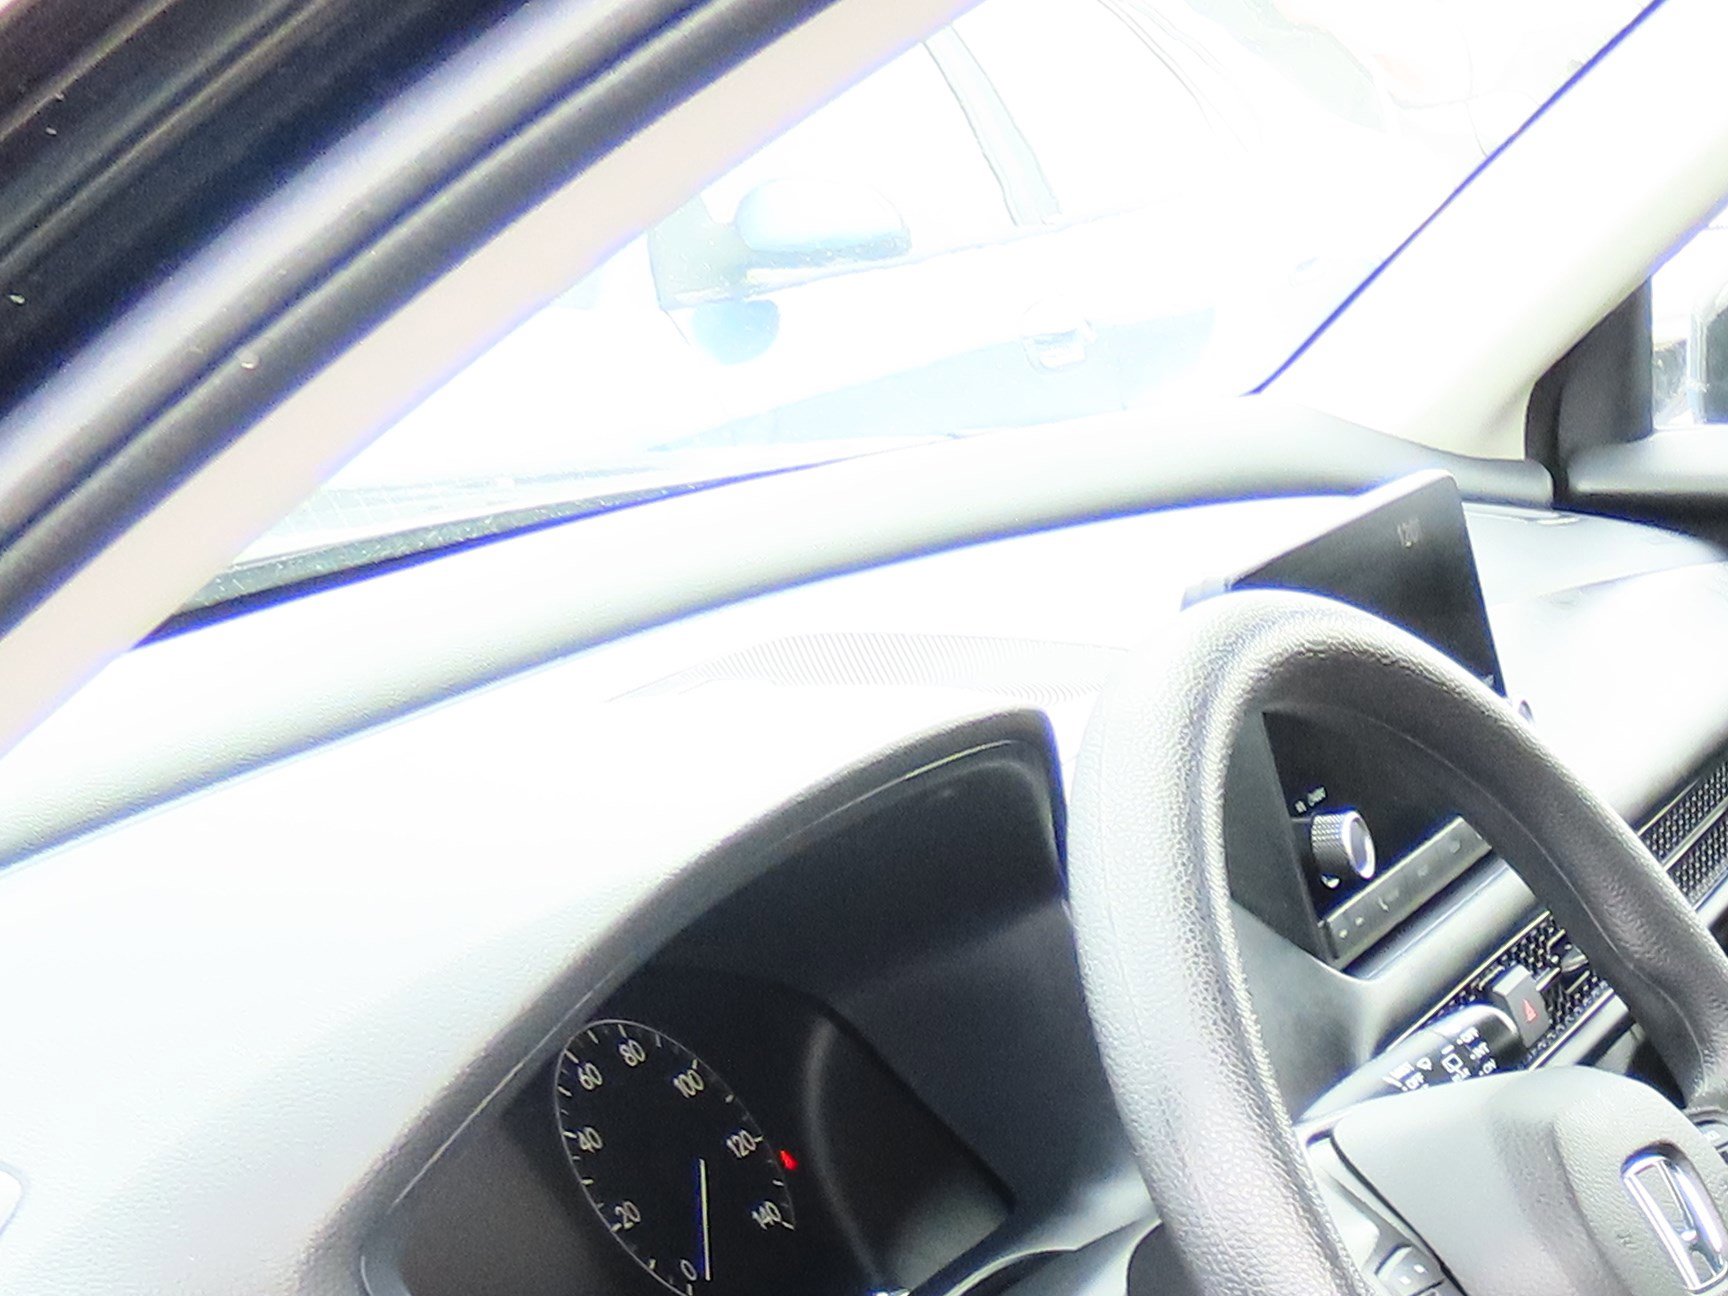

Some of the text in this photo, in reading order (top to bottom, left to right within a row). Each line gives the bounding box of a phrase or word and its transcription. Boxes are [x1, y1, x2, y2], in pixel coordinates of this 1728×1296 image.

[619, 1040, 646, 1068] 80
[577, 1064, 602, 1092] 60
[673, 1069, 704, 1098] 100
[578, 1127, 603, 1152] 40
[727, 1131, 757, 1159] 120
[616, 1200, 641, 1228] 20
[752, 1201, 783, 1229] 140
[681, 1260, 698, 1282] 0
